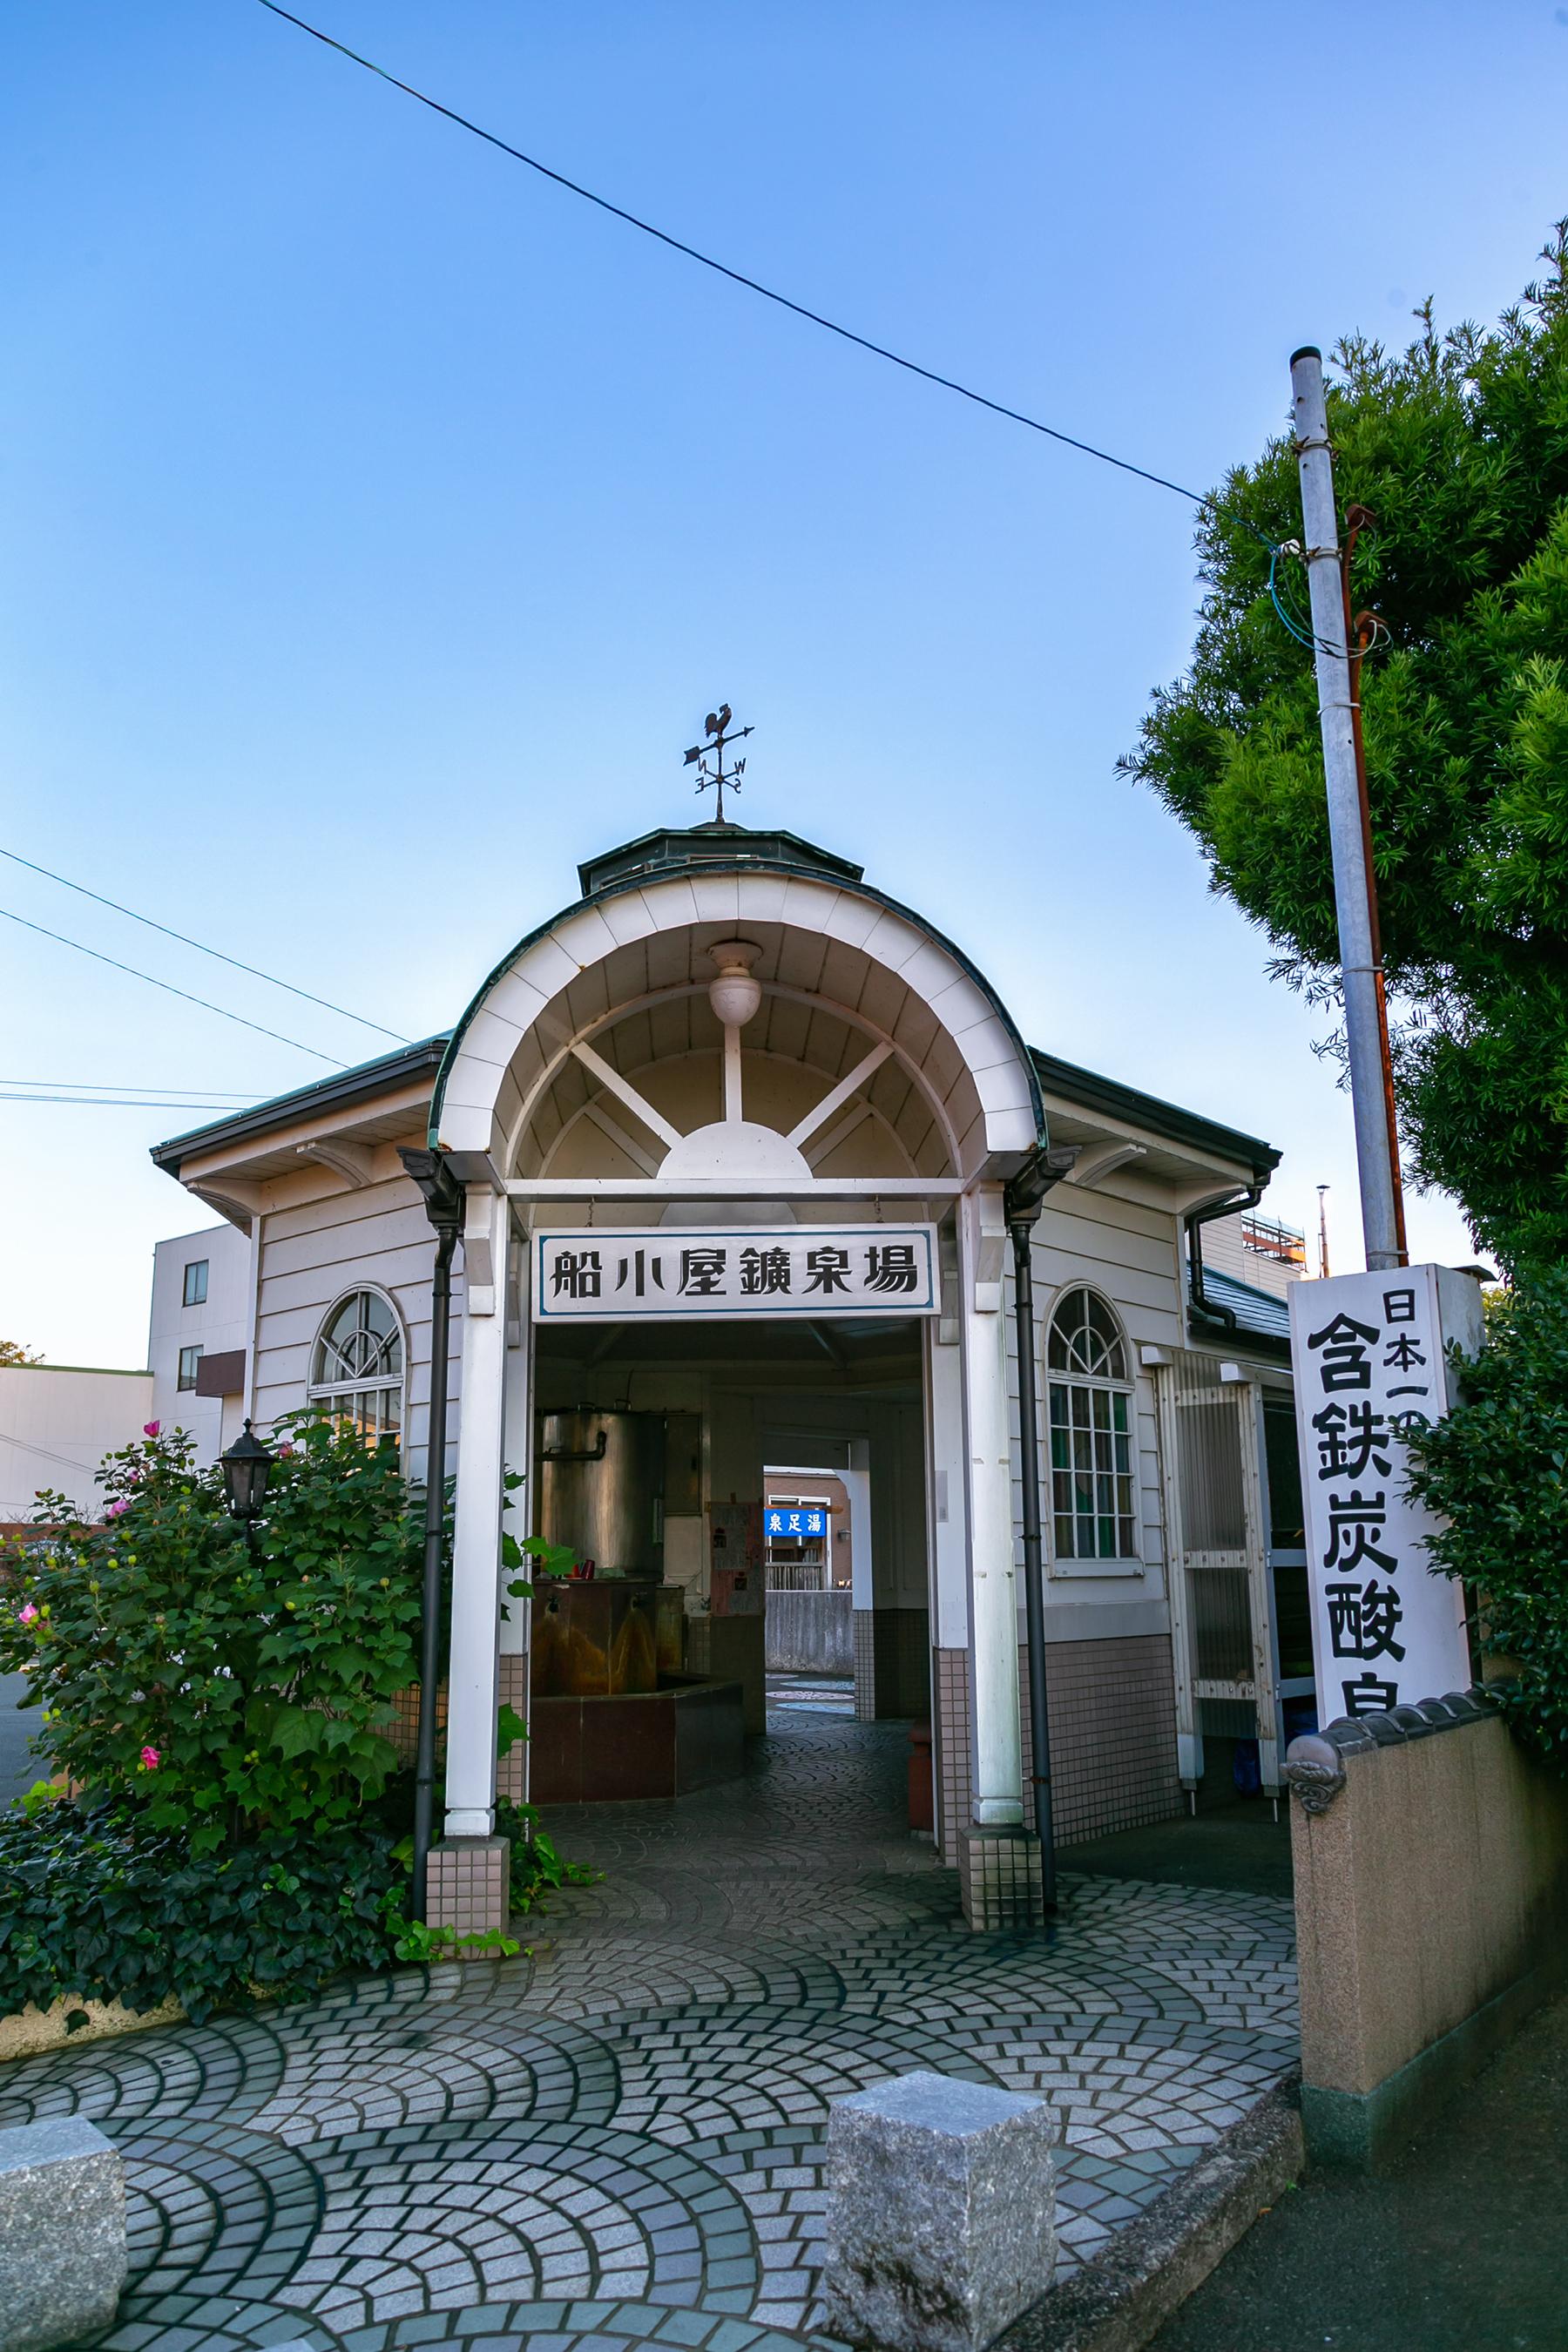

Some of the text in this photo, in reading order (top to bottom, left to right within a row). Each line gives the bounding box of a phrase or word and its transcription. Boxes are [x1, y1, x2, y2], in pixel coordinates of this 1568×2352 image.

[549, 1245, 918, 1299] 船小屋鑛泉場
[768, 1512, 822, 1532] 泉足湯
